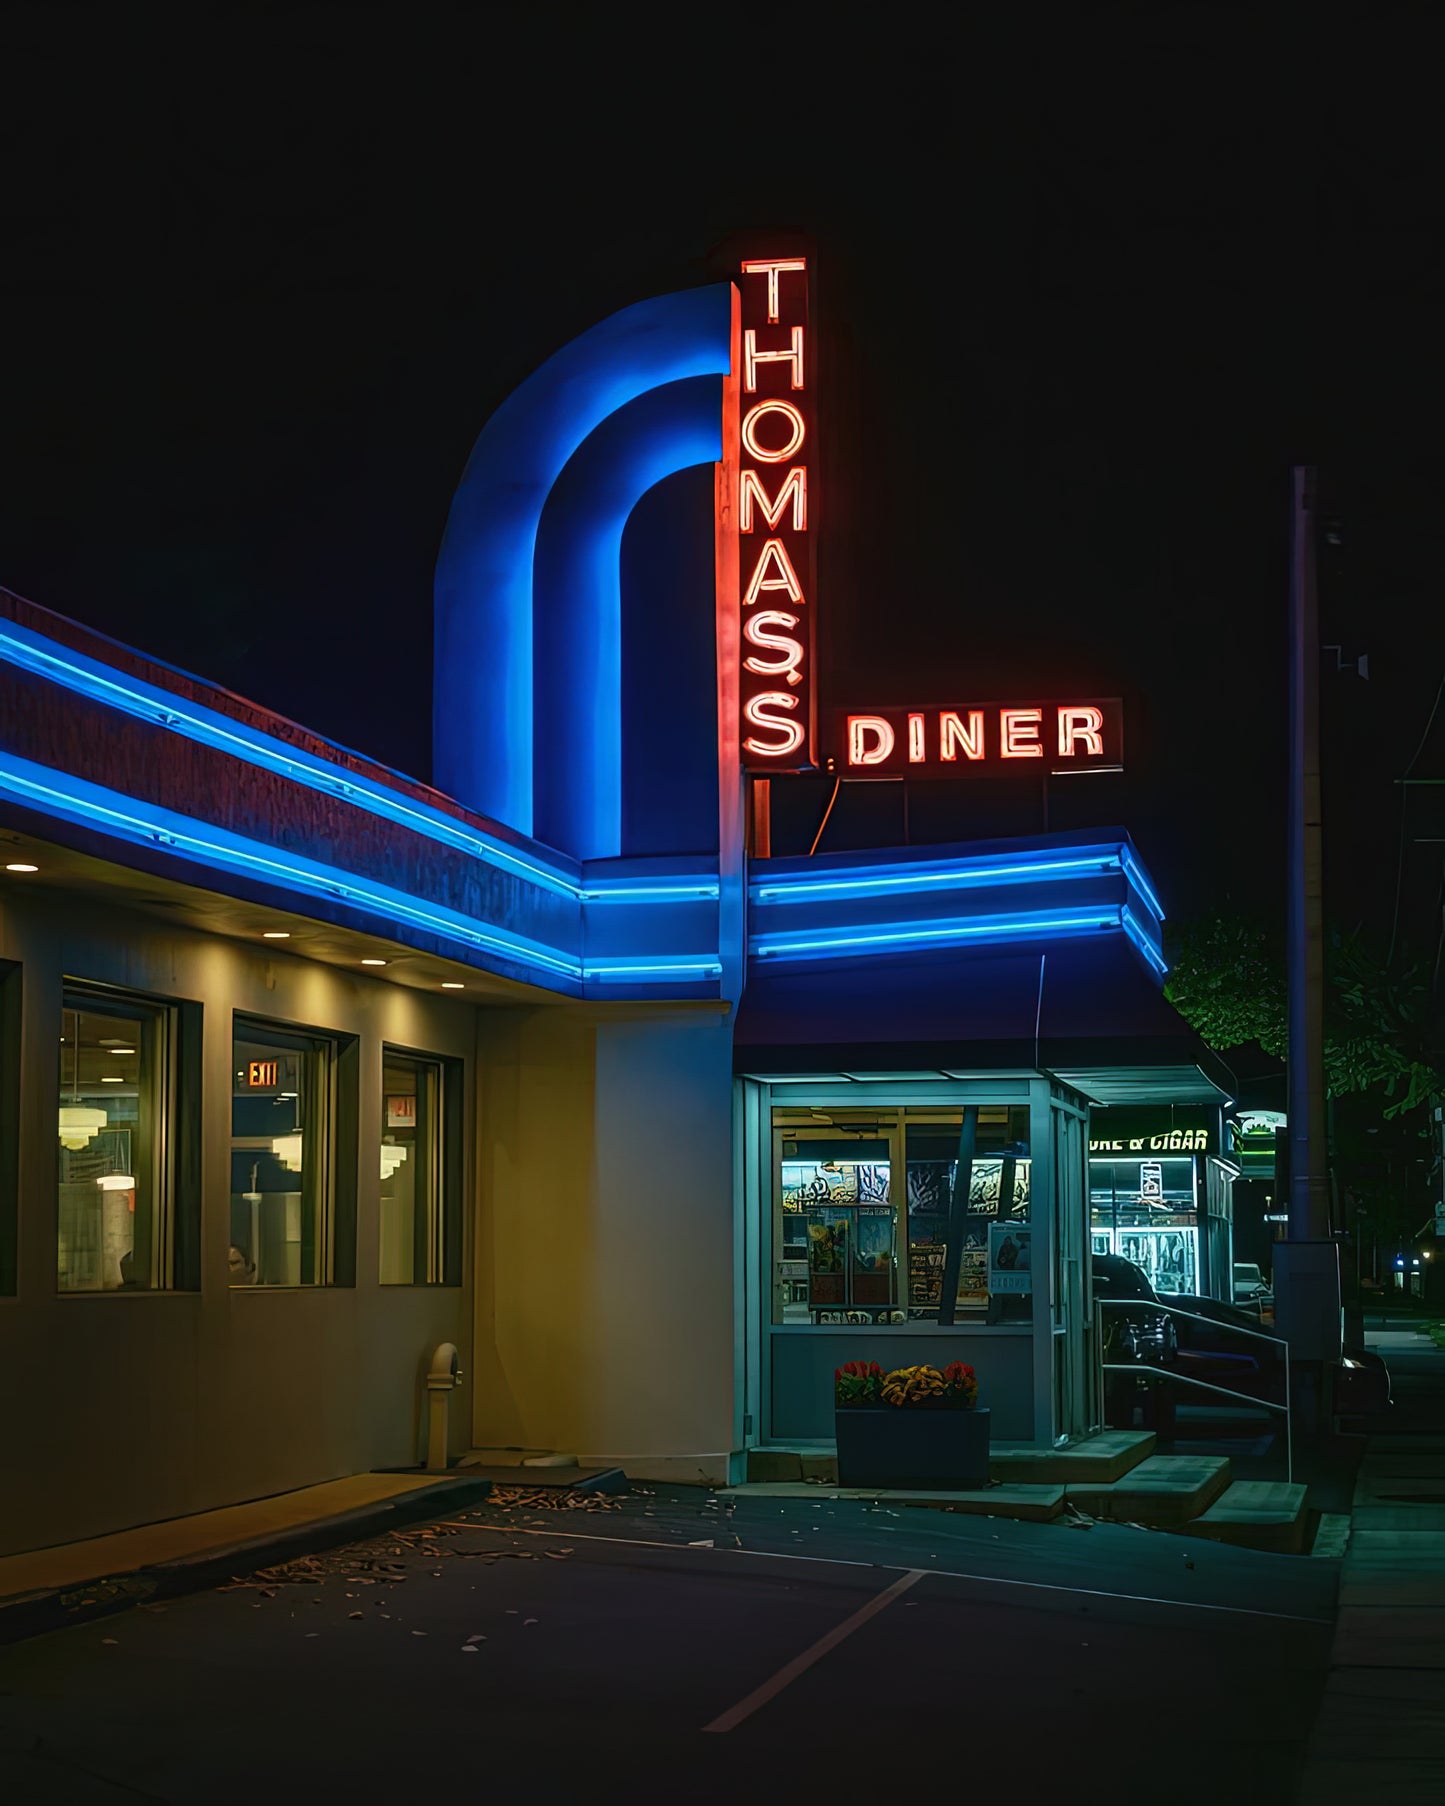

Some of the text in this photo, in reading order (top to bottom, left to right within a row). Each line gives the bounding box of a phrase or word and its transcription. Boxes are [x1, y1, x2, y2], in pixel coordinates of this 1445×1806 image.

[848, 706, 1104, 766] DINER
[249, 1062, 278, 1087] EXIT
[1150, 1129, 1208, 1150] CIGAR
